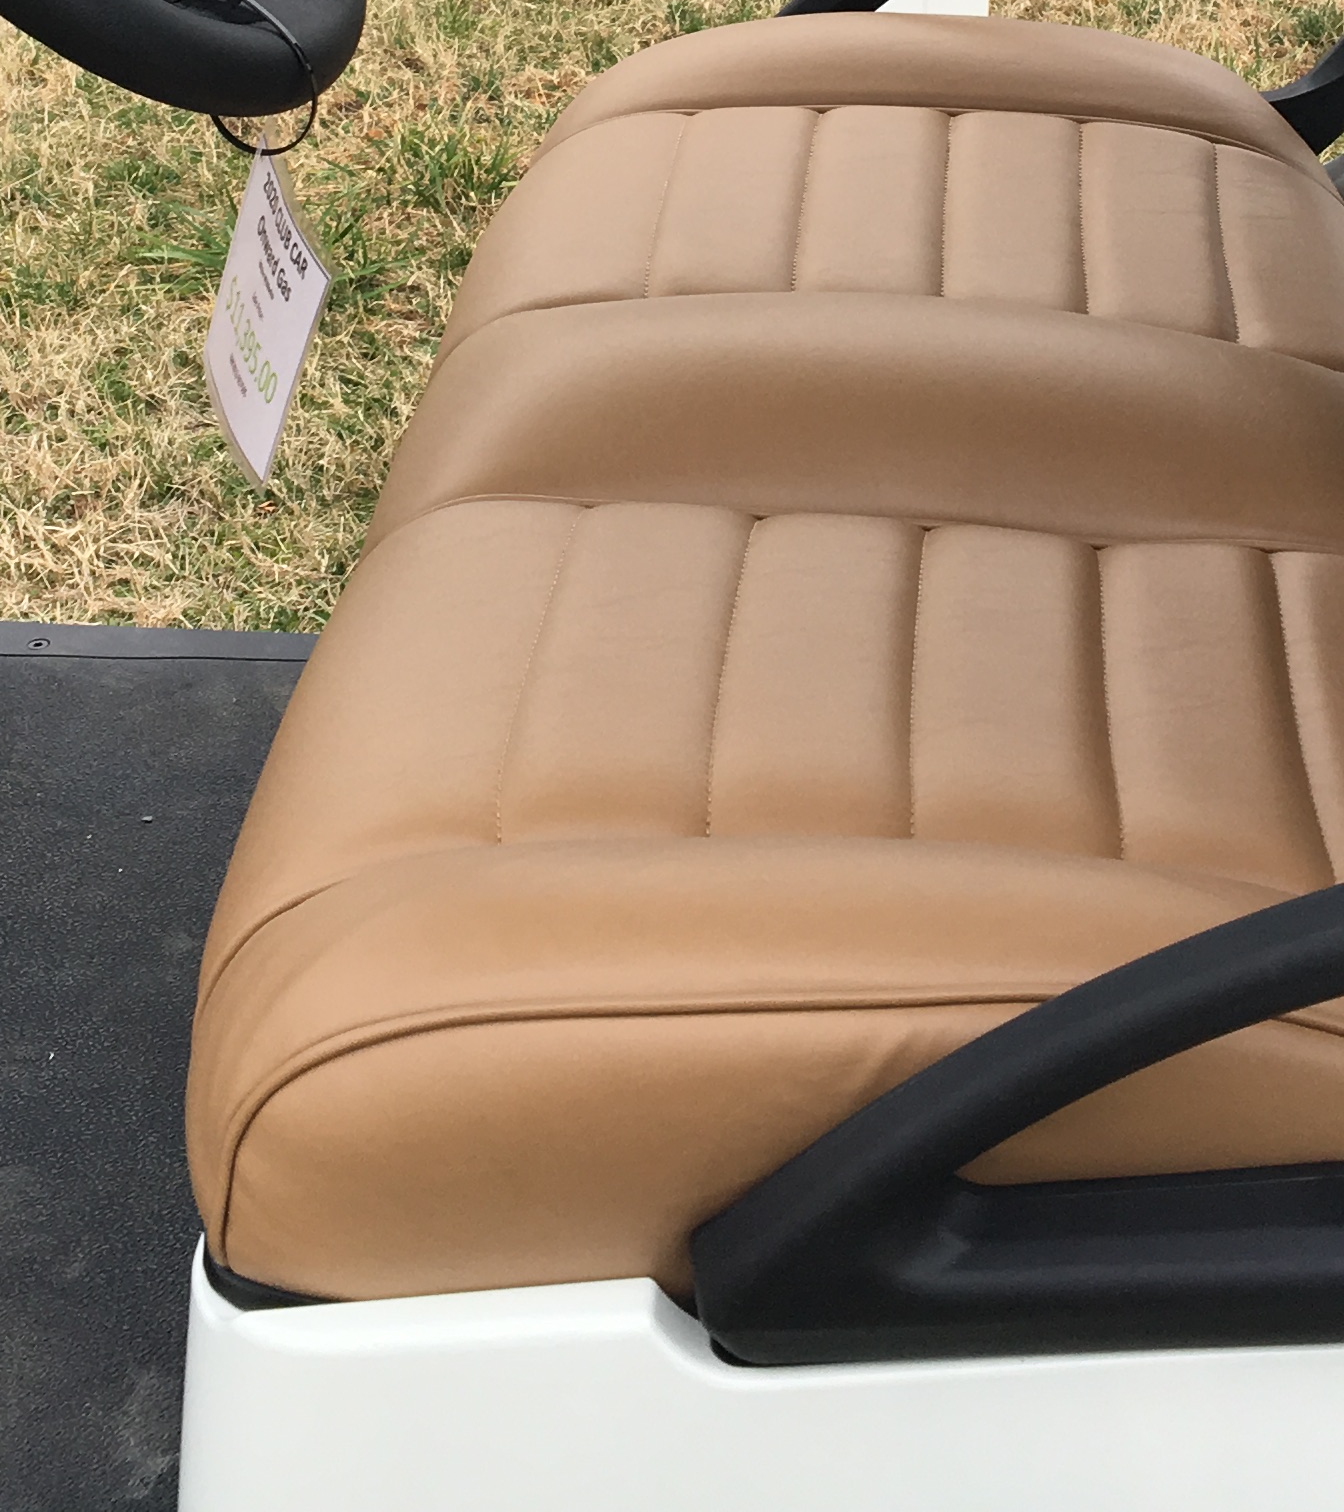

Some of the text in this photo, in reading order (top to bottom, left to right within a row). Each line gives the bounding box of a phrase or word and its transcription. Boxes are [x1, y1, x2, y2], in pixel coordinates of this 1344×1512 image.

[257, 214, 280, 277] Onward
[276, 267, 292, 303] Gas
[275, 206, 292, 250] CLUB
[289, 242, 309, 281] CAR
